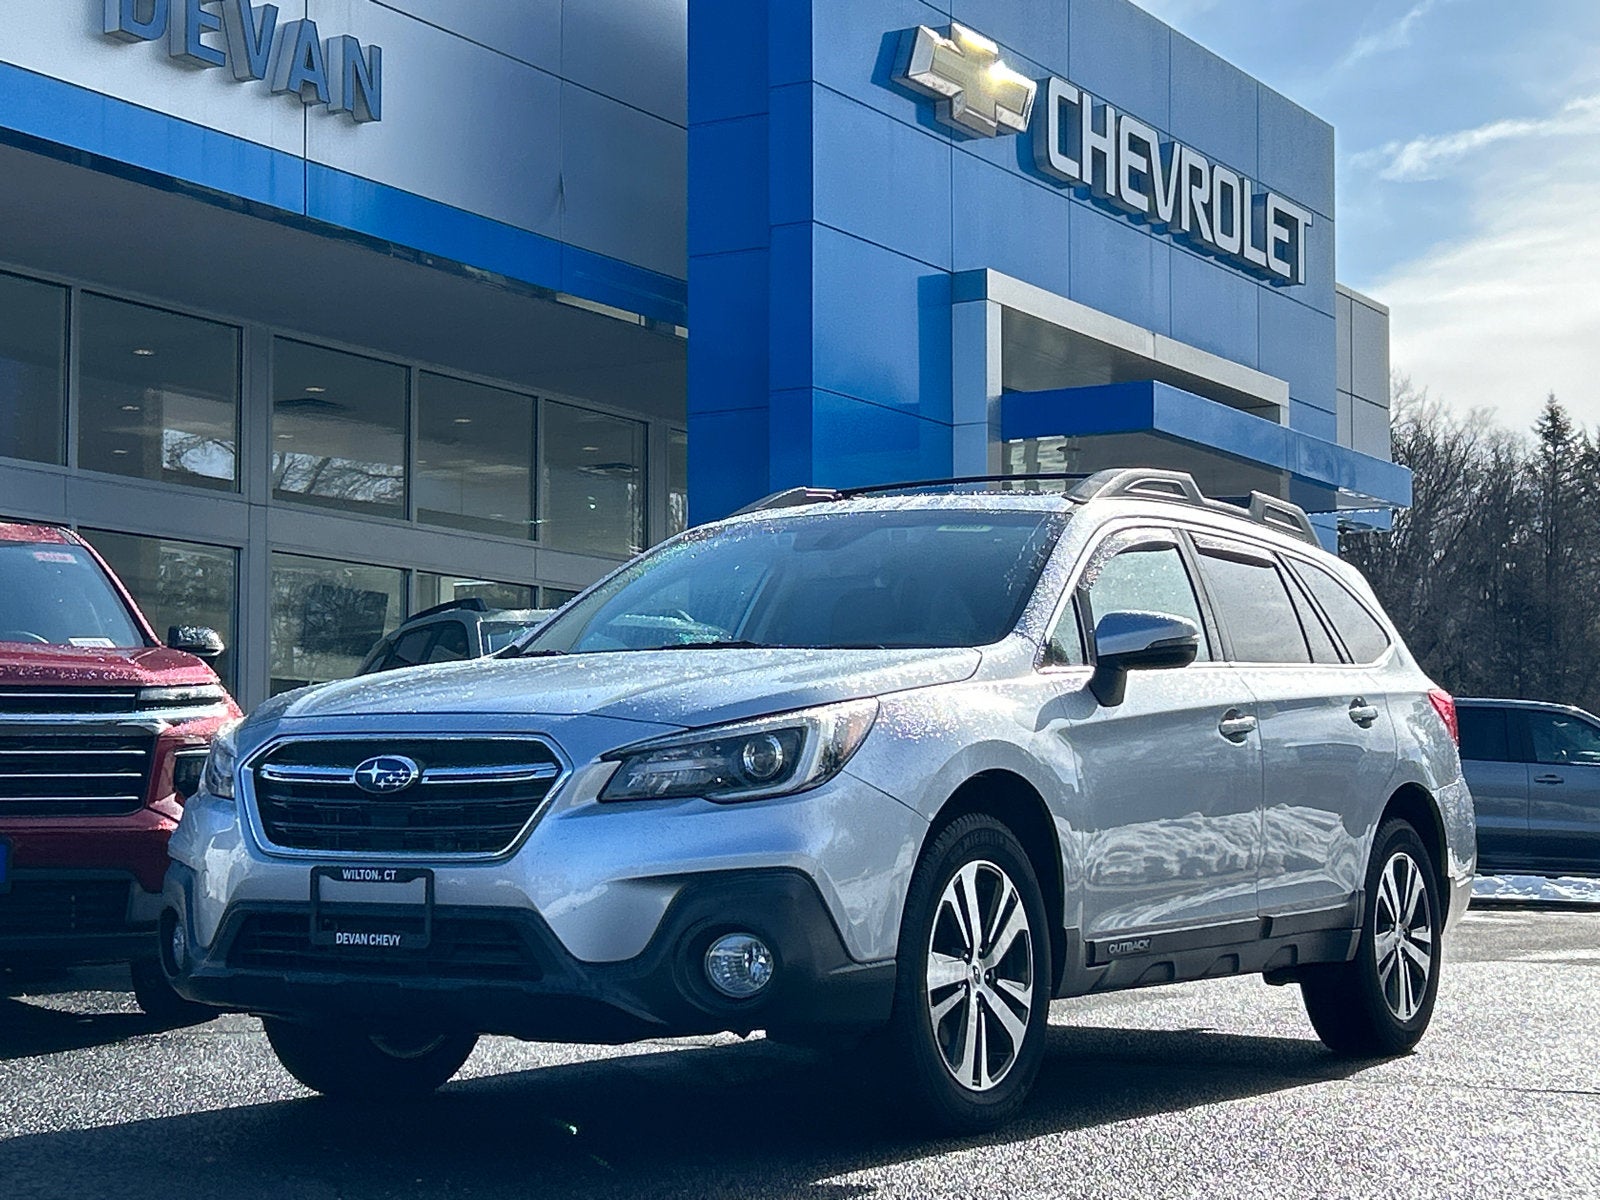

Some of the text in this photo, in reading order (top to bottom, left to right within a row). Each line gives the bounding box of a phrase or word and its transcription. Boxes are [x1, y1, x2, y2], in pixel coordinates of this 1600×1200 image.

[1047, 76, 1313, 285] CHEVROLET
[384, 870, 397, 881] CT
[336, 932, 401, 946] DEVAN CHEVY
[1109, 939, 1150, 953] OUTBACK
